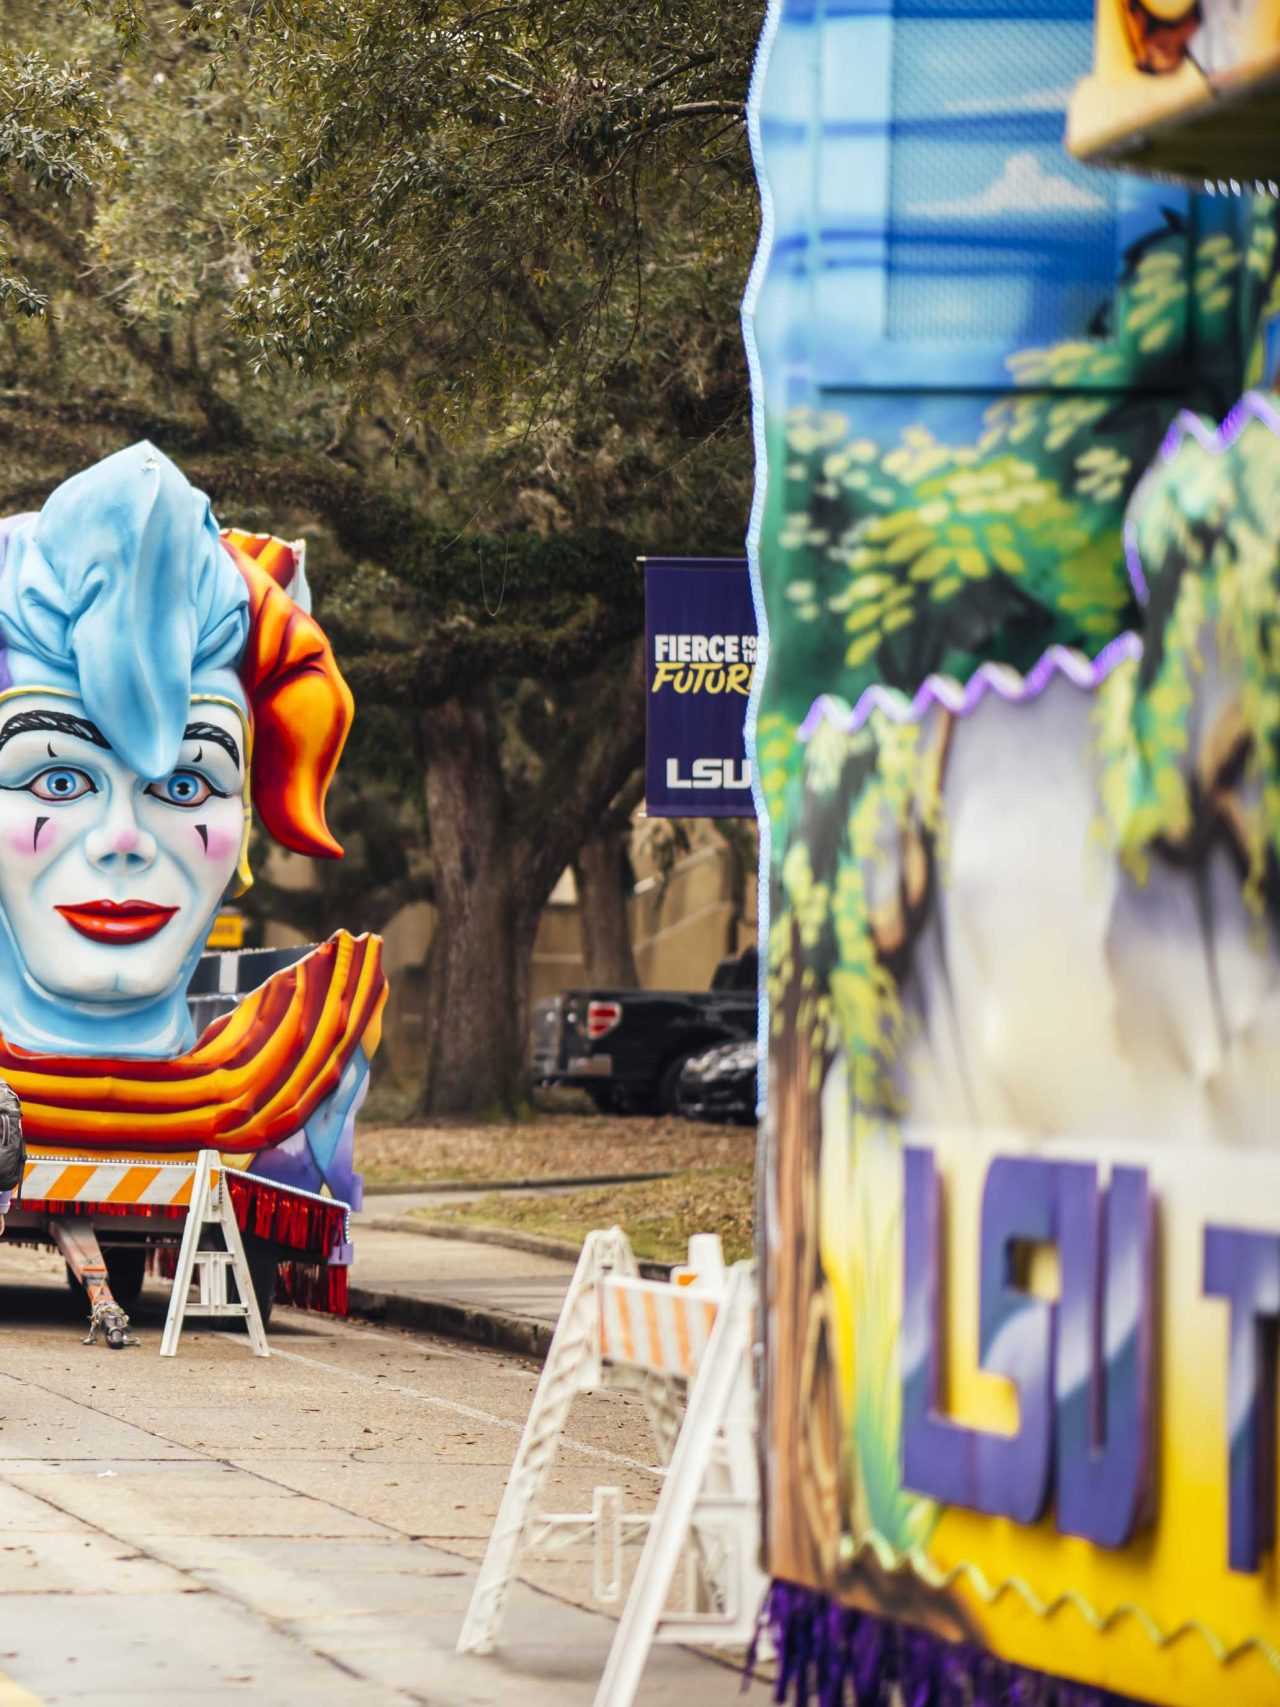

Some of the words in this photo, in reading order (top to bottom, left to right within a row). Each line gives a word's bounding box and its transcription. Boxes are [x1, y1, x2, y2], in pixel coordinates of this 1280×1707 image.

[655, 635, 739, 662] FIERCE
[742, 636, 758, 650] FO
[743, 650, 757, 663] TH
[666, 758, 751, 788] LSU
[902, 1145, 1150, 1550] LSU
